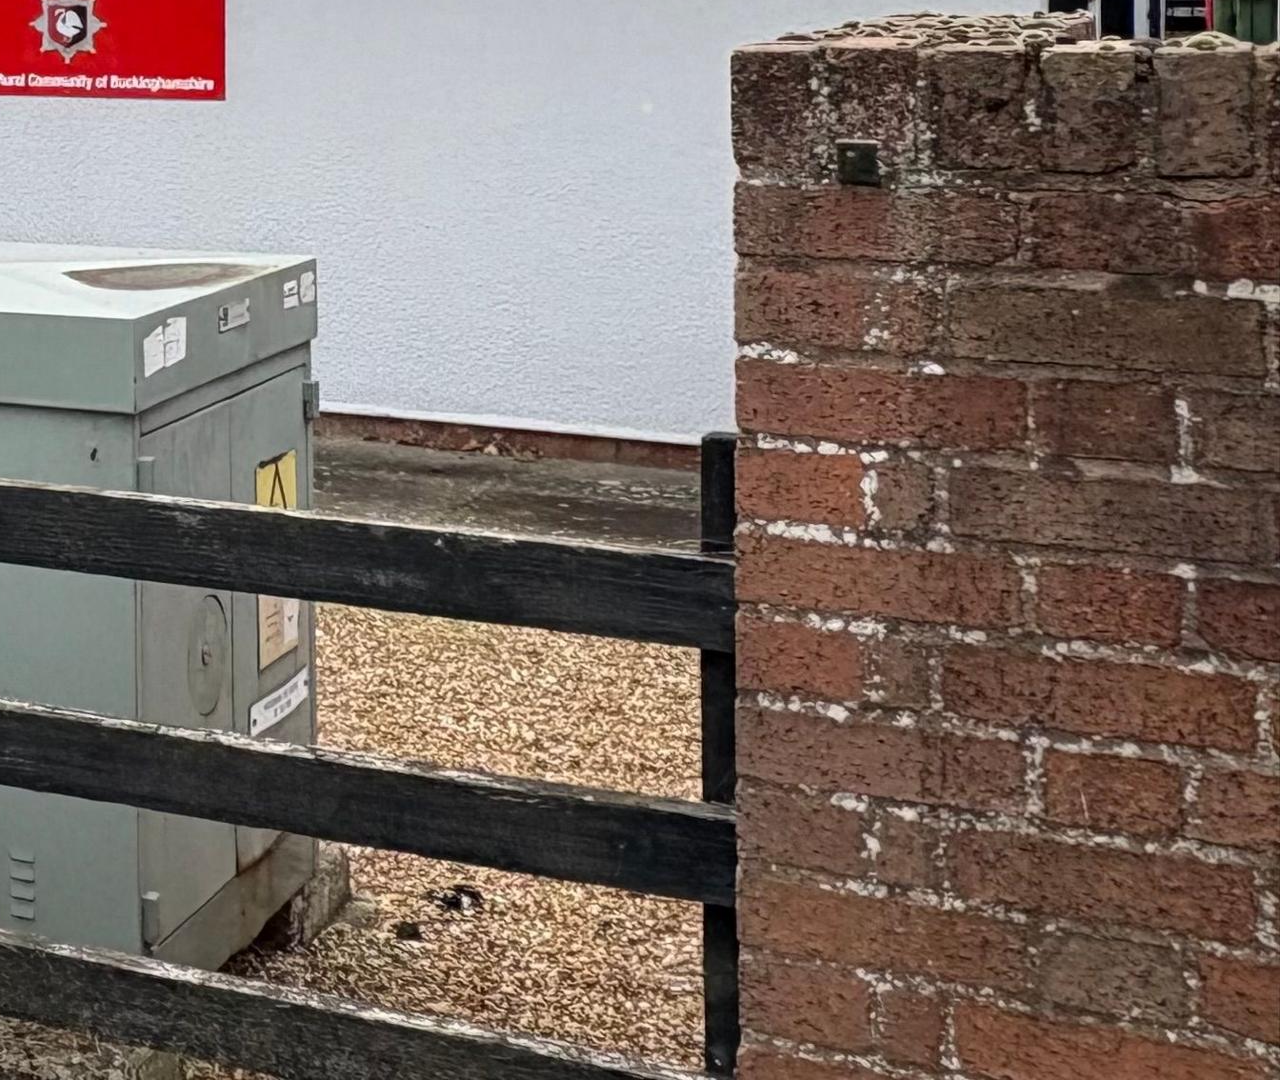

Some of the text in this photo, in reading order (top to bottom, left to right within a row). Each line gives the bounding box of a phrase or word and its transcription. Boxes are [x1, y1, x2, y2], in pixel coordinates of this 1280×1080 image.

[28, 73, 93, 91] Community
[95, 75, 108, 88] of
[110, 75, 215, 92] Buckinghamshire
